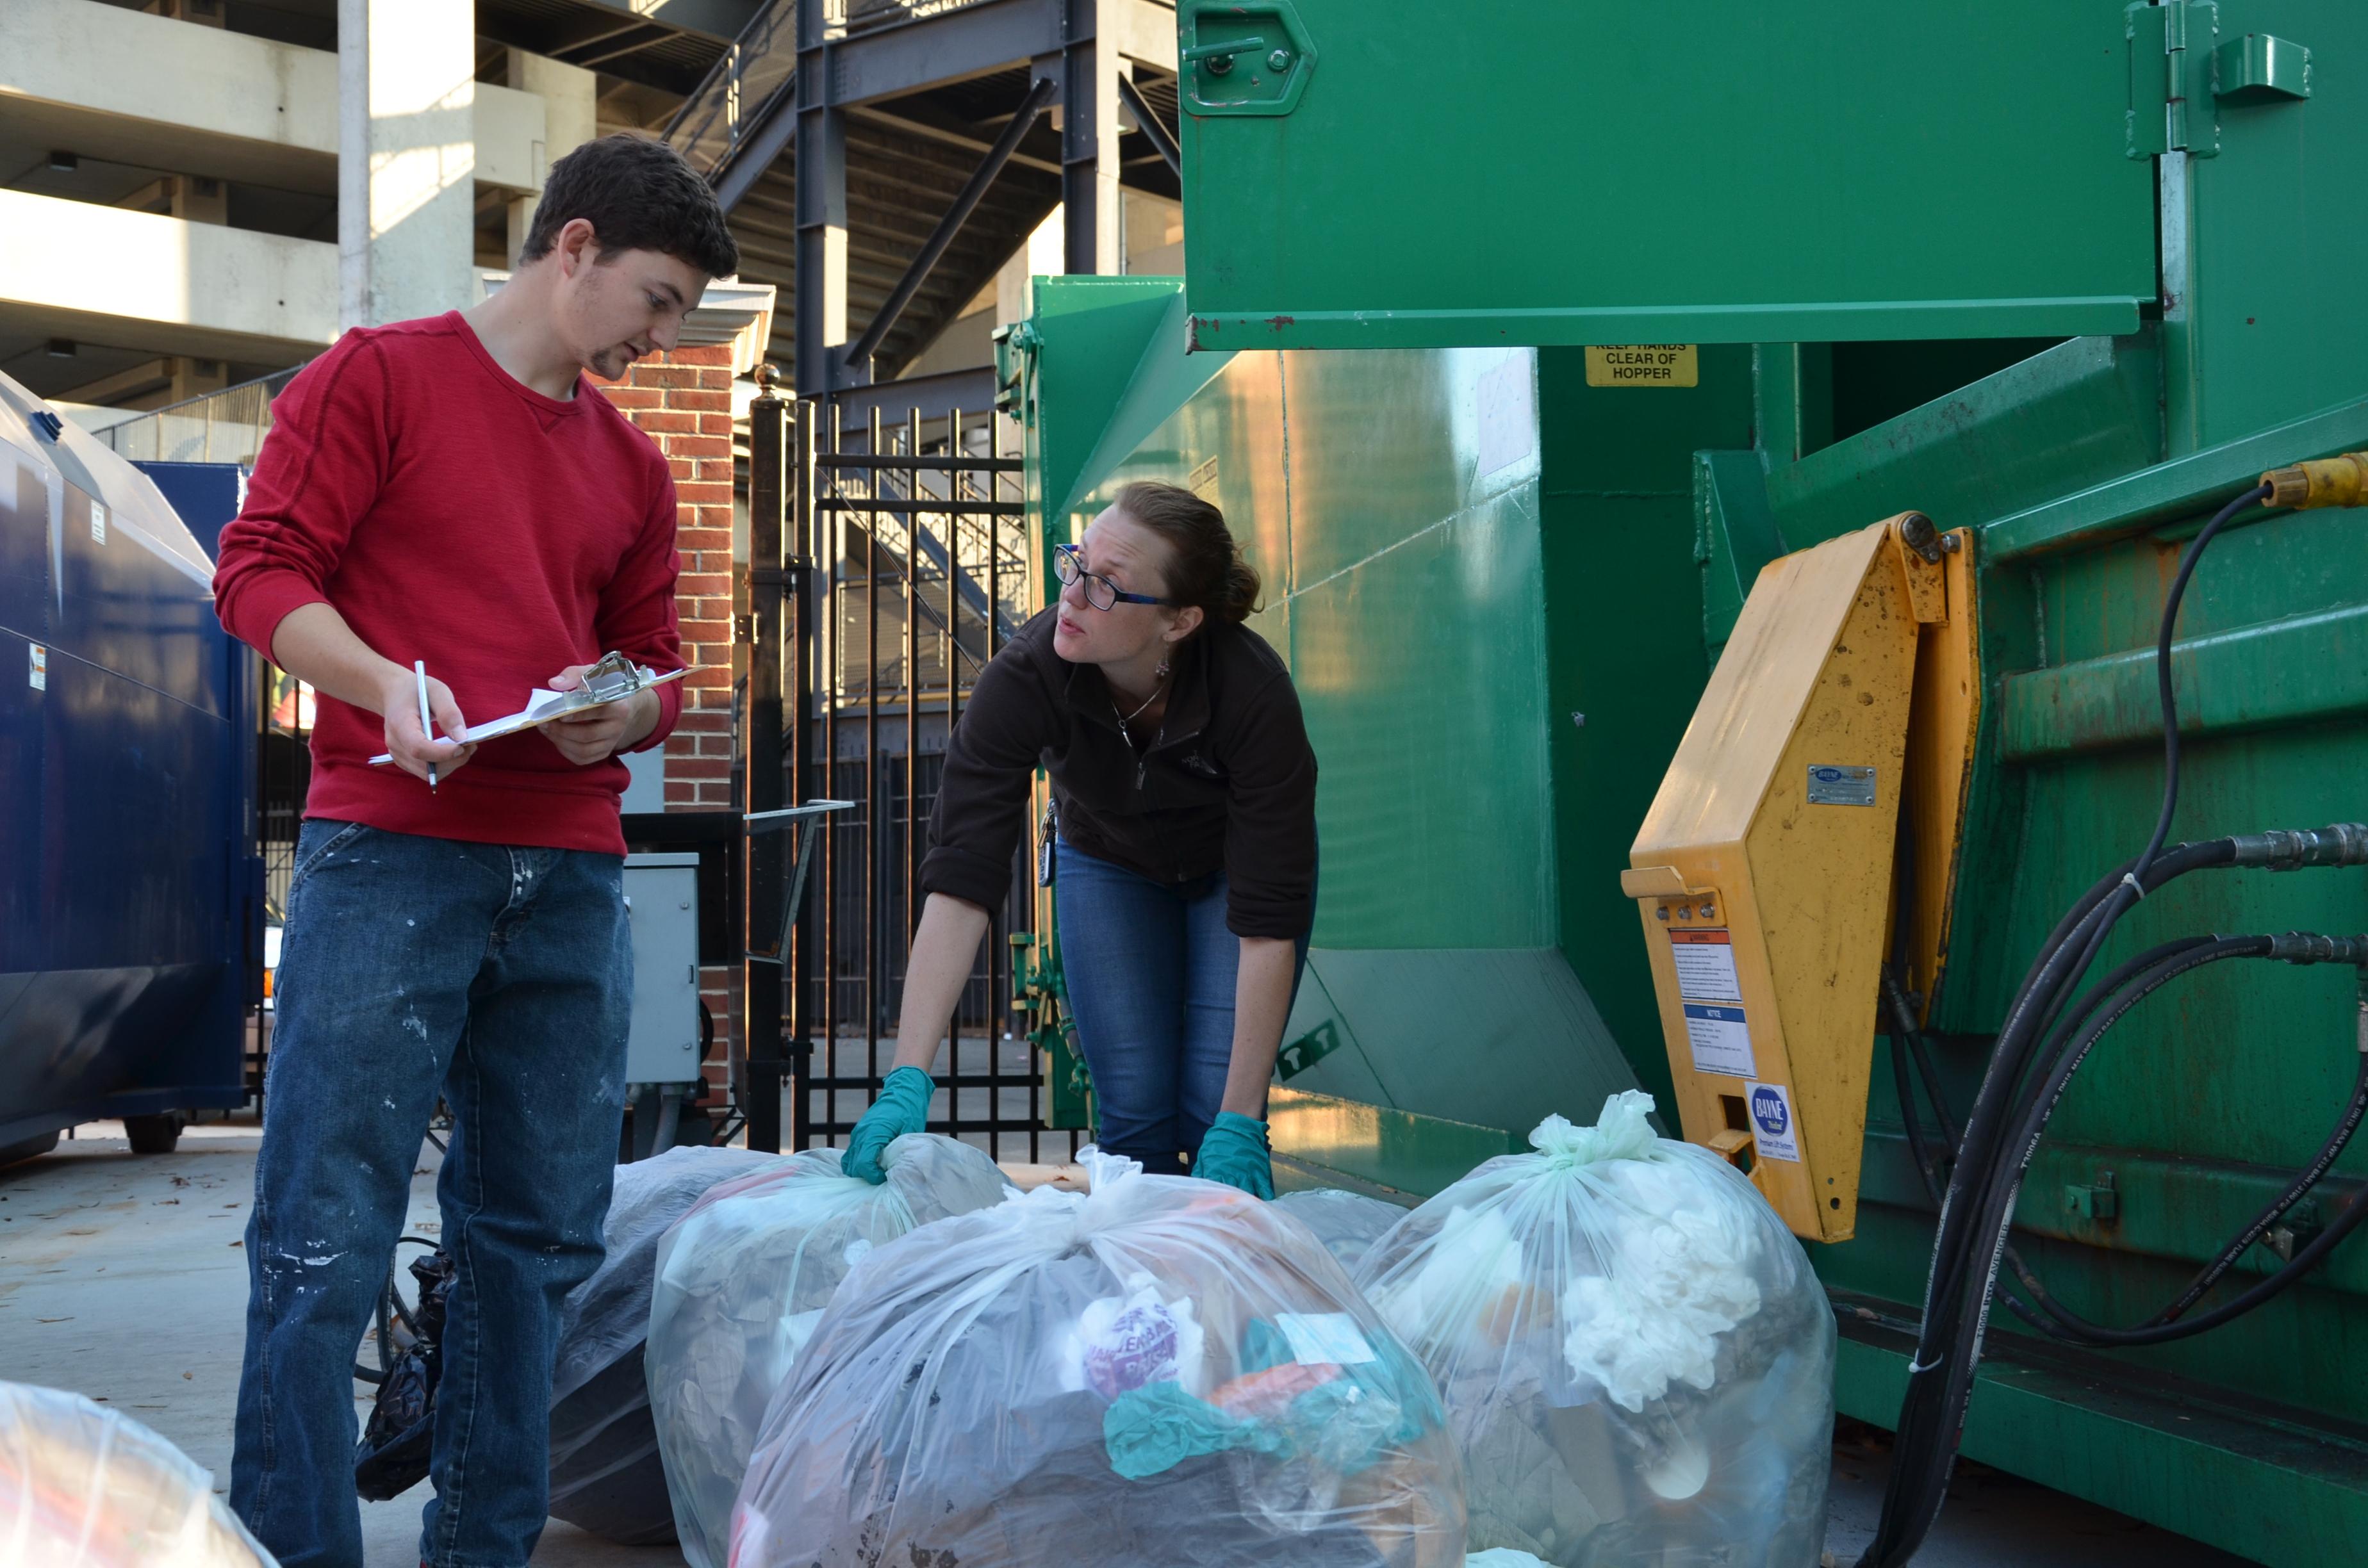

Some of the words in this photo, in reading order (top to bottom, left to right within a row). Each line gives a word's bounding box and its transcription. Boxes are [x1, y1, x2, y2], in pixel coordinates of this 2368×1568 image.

[1606, 353, 1654, 364] CLEAR
[1658, 354, 1676, 364] OF
[1613, 367, 1671, 379] HOPPER
[2019, 1130, 2042, 1170] T3006A
[2057, 1072, 2073, 1092] DN10
[2070, 1052, 2085, 1071] MAX
[2080, 1040, 2094, 1055] WP
[2100, 1015, 2116, 1032] BAR
[2190, 952, 2216, 967] FLAME
[2216, 945, 2257, 958] RESISTANT
[1755, 1098, 1783, 1120] BAYNE
[2346, 1106, 2360, 1128] DN10
[2334, 1127, 2349, 1146] MAX
[2326, 1143, 2339, 1158] WP
[2287, 1184, 2305, 1200] 3100
[2224, 1243, 2244, 1263] FLAME
[1976, 1309, 1988, 1339] T3000
[1989, 1223, 2009, 1275] AVENGER
